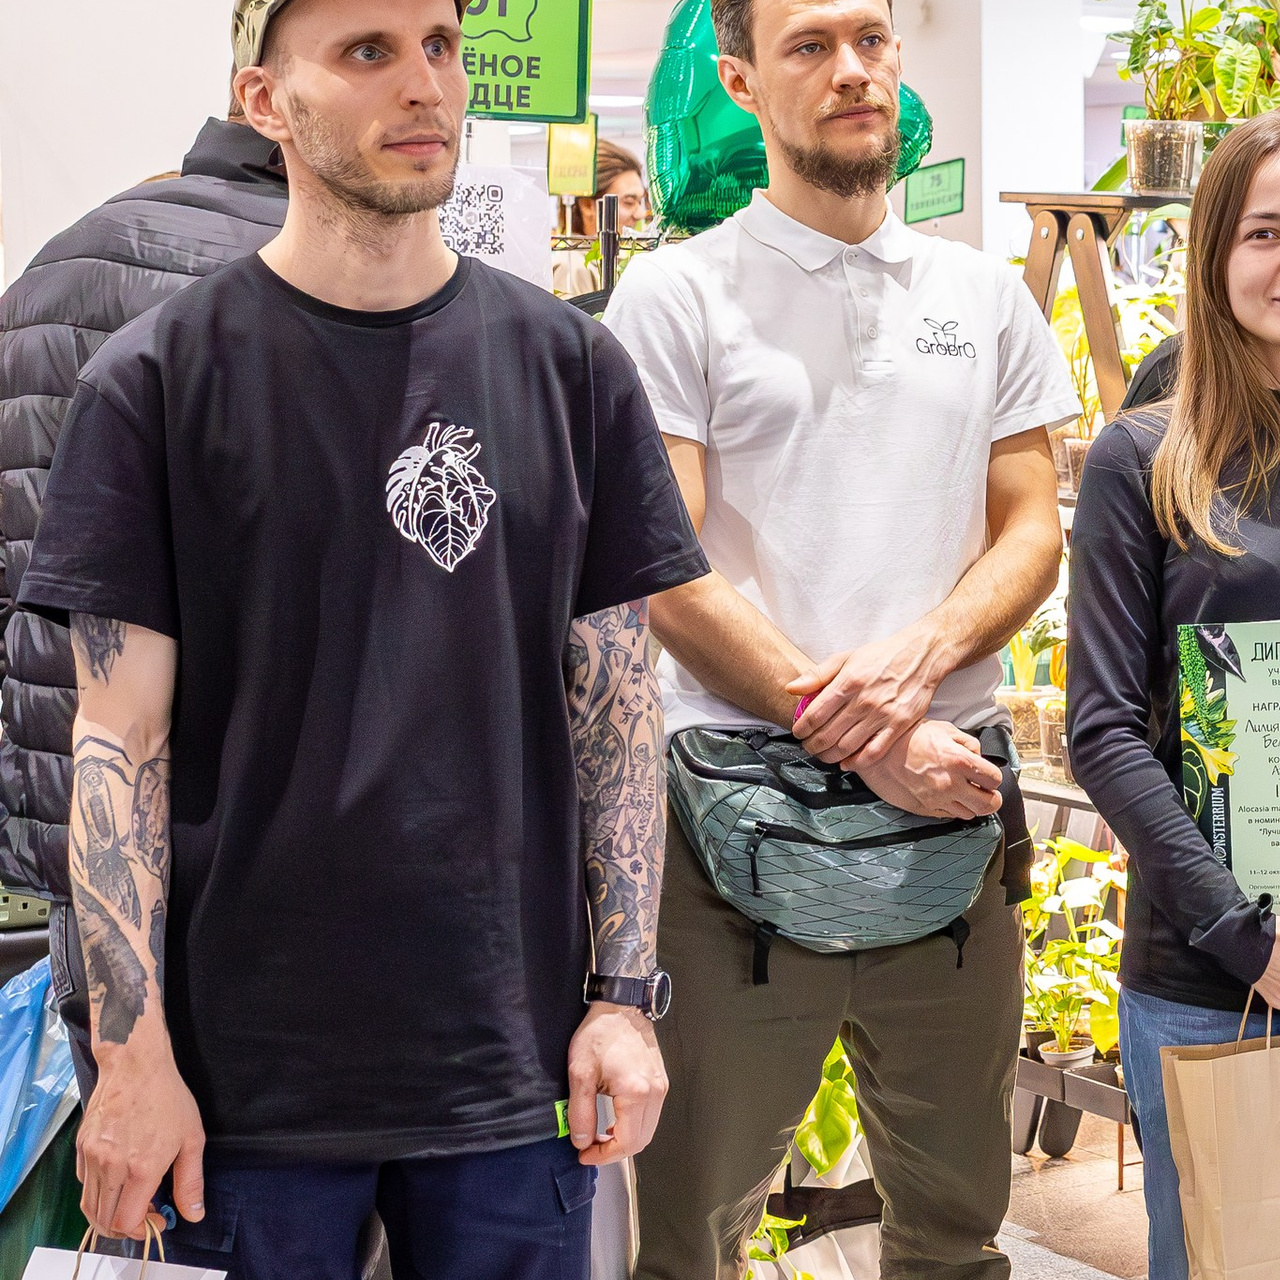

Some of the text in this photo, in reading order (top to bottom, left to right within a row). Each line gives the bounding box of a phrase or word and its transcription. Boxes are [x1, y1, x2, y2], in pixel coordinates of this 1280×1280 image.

[462, 46, 541, 79] ЁНОЕ
[469, 82, 531, 111] ДЦЕ
[1245, 719, 1279, 733] Лилия
[1237, 805, 1270, 813] Alocasia
